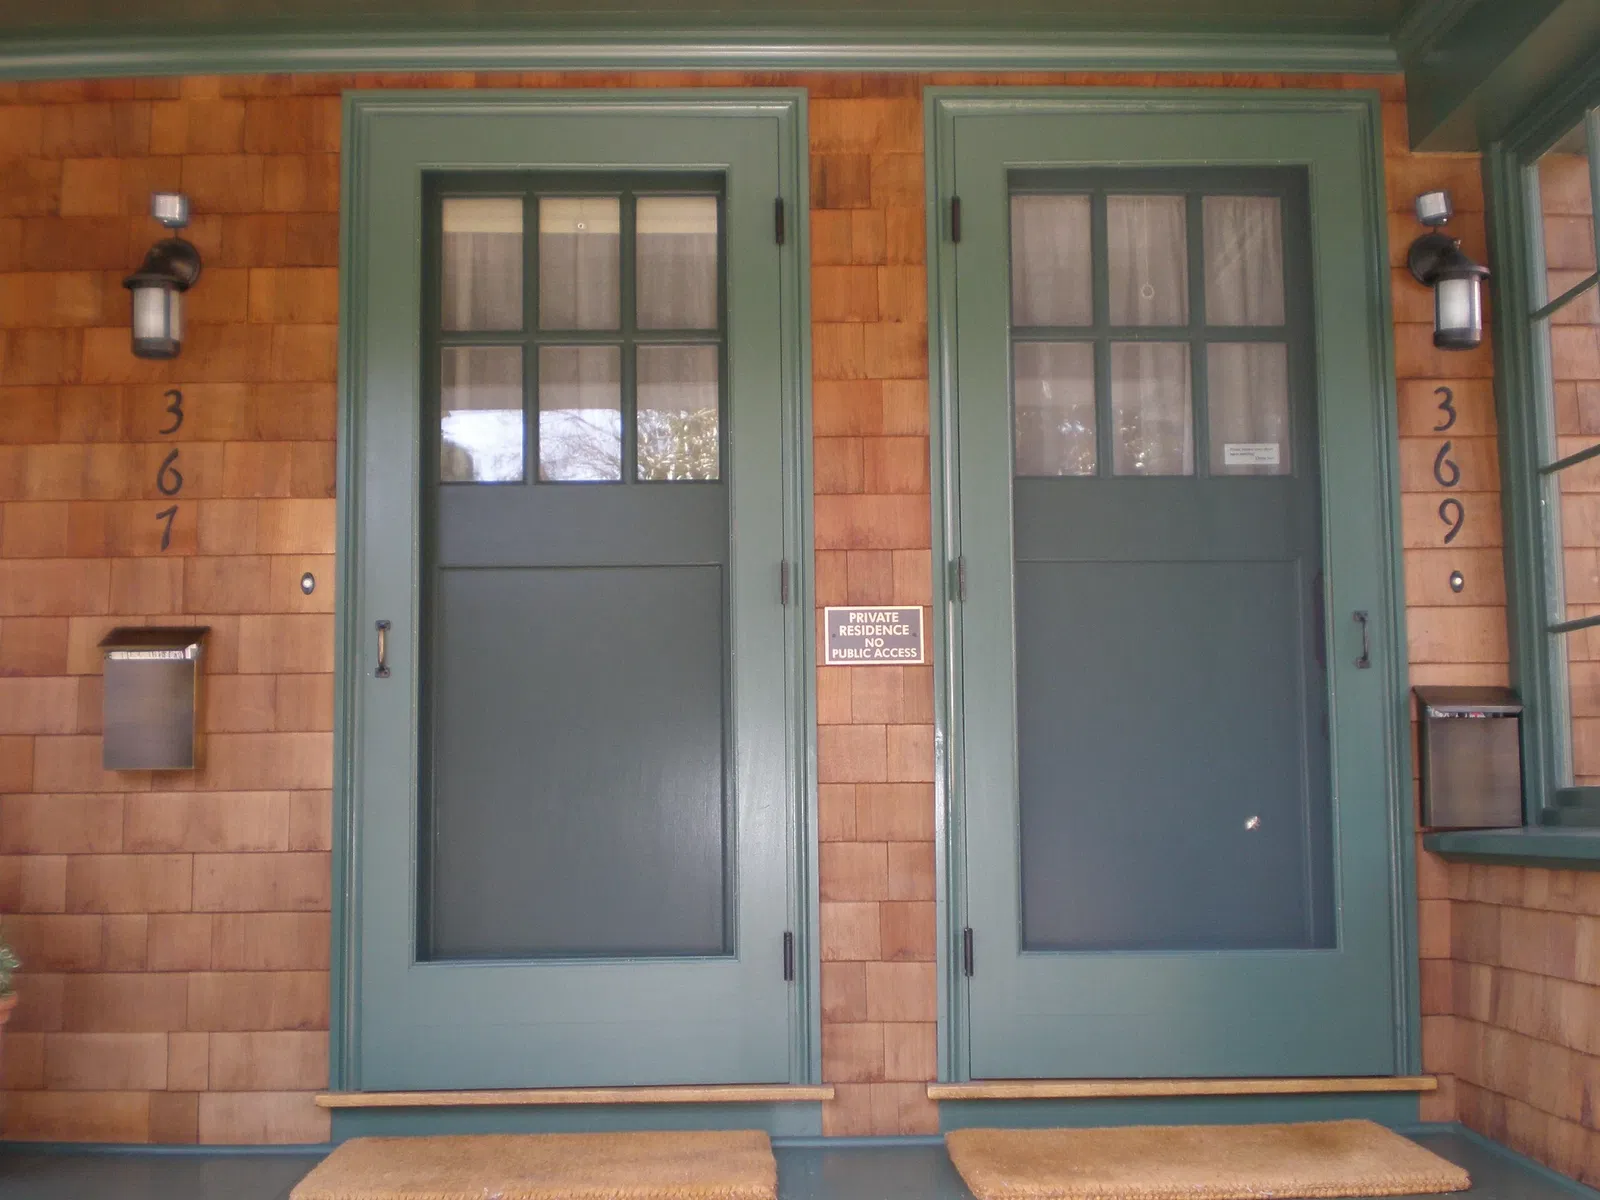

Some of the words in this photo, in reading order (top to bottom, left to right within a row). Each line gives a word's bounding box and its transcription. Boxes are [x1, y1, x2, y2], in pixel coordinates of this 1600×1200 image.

[156, 389, 184, 552] 367
[1433, 386, 1465, 545] 369
[849, 612, 899, 623] PRIVATE
[839, 625, 909, 636] RESIDENCE
[864, 637, 884, 647] NO
[832, 648, 871, 658] PUBLIC
[874, 647, 917, 658] ACCESS
